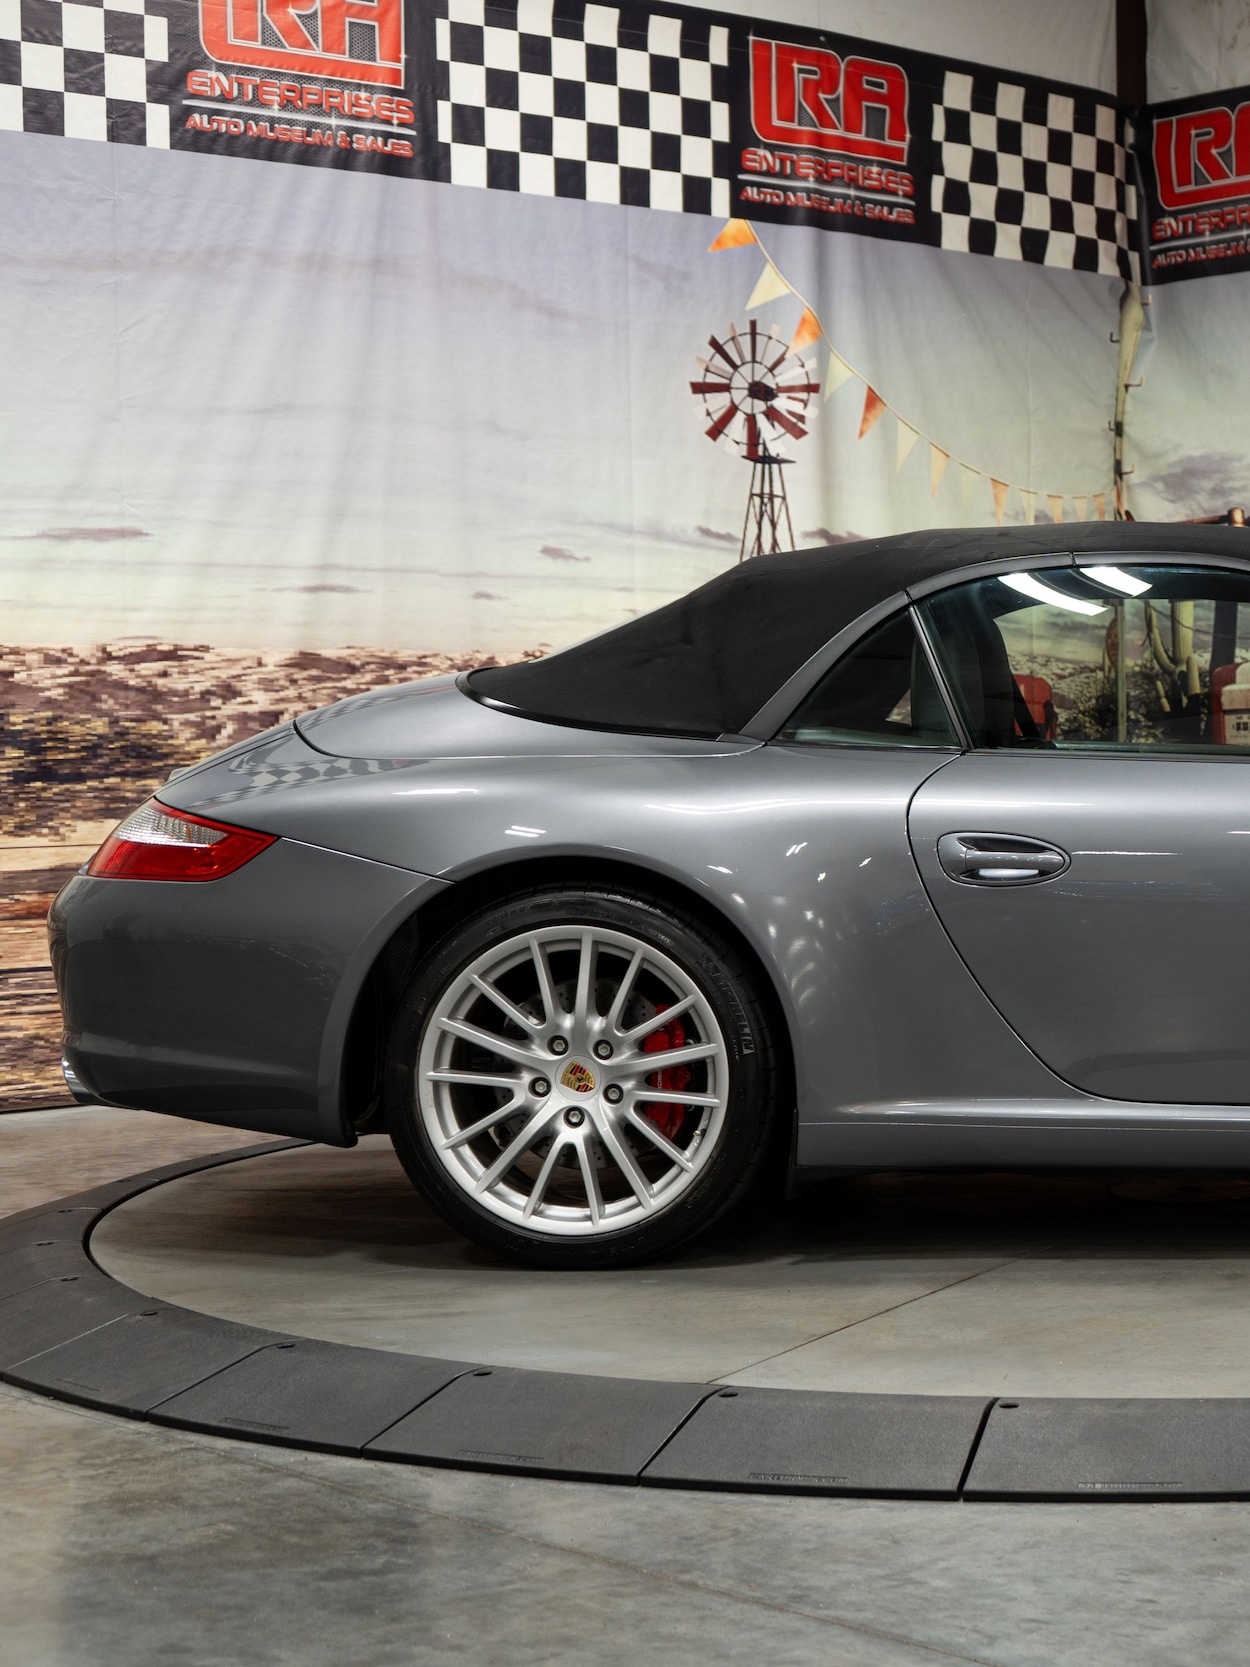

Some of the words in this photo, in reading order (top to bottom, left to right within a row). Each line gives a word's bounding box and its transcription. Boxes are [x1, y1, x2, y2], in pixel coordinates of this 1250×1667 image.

[185, 68, 415, 126] ENTERPRISES
[748, 35, 911, 166] LRA
[185, 112, 245, 136] AUTO
[246, 120, 334, 147] MUSEUM
[336, 130, 351, 149] &
[352, 133, 415, 158] SALES
[740, 147, 916, 196] ENTERPRISES
[739, 185, 785, 206] AUTO
[785, 190, 853, 214] MUSEUM
[853, 200, 864, 218] &
[864, 202, 916, 225] SALES
[1151, 248, 1187, 269] AUTO
[1186, 238, 1246, 264] MUSEUM
